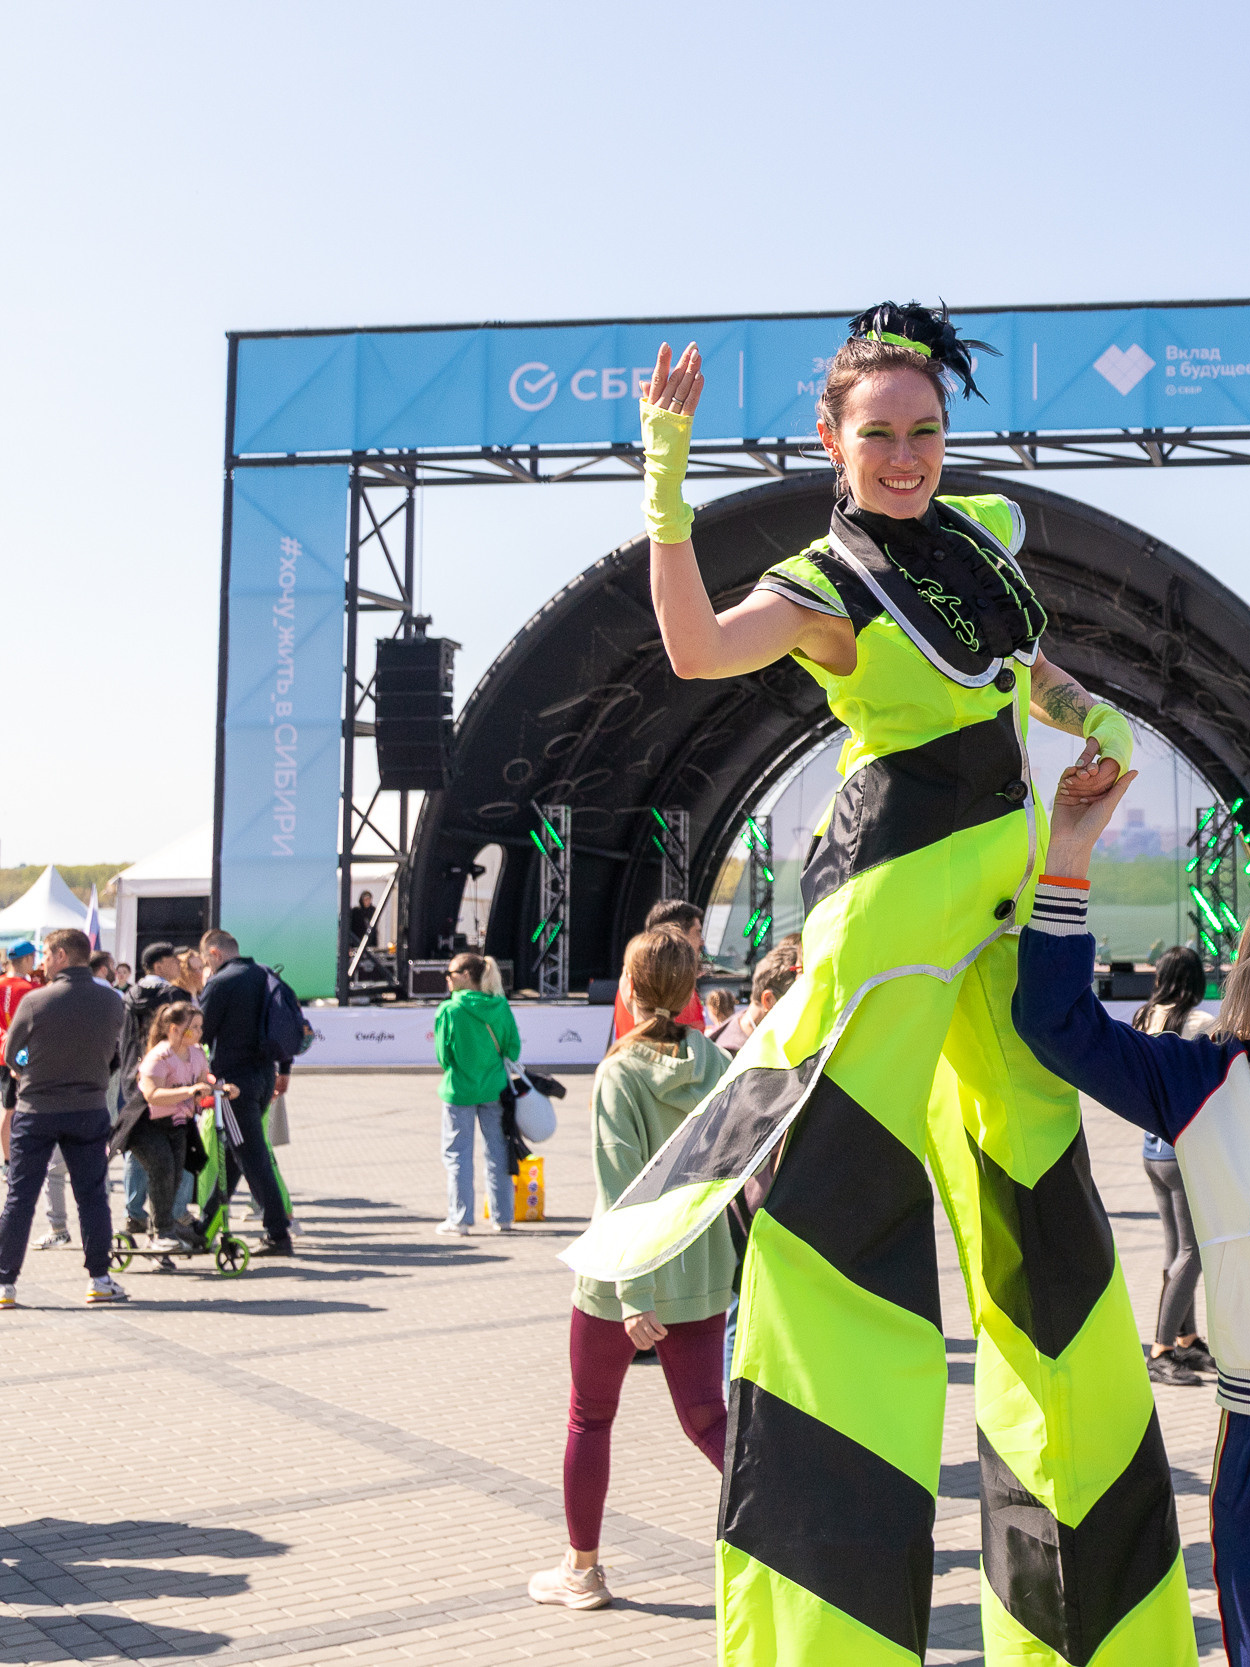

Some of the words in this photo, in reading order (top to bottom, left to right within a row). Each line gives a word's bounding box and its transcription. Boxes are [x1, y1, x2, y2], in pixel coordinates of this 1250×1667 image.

[1166, 345, 1221, 361] Вклад
[1166, 365, 1176, 377] в
[570, 367, 676, 401] СБЕ
[270, 537, 302, 857] #хочу_жить_в_СИБИРИ
